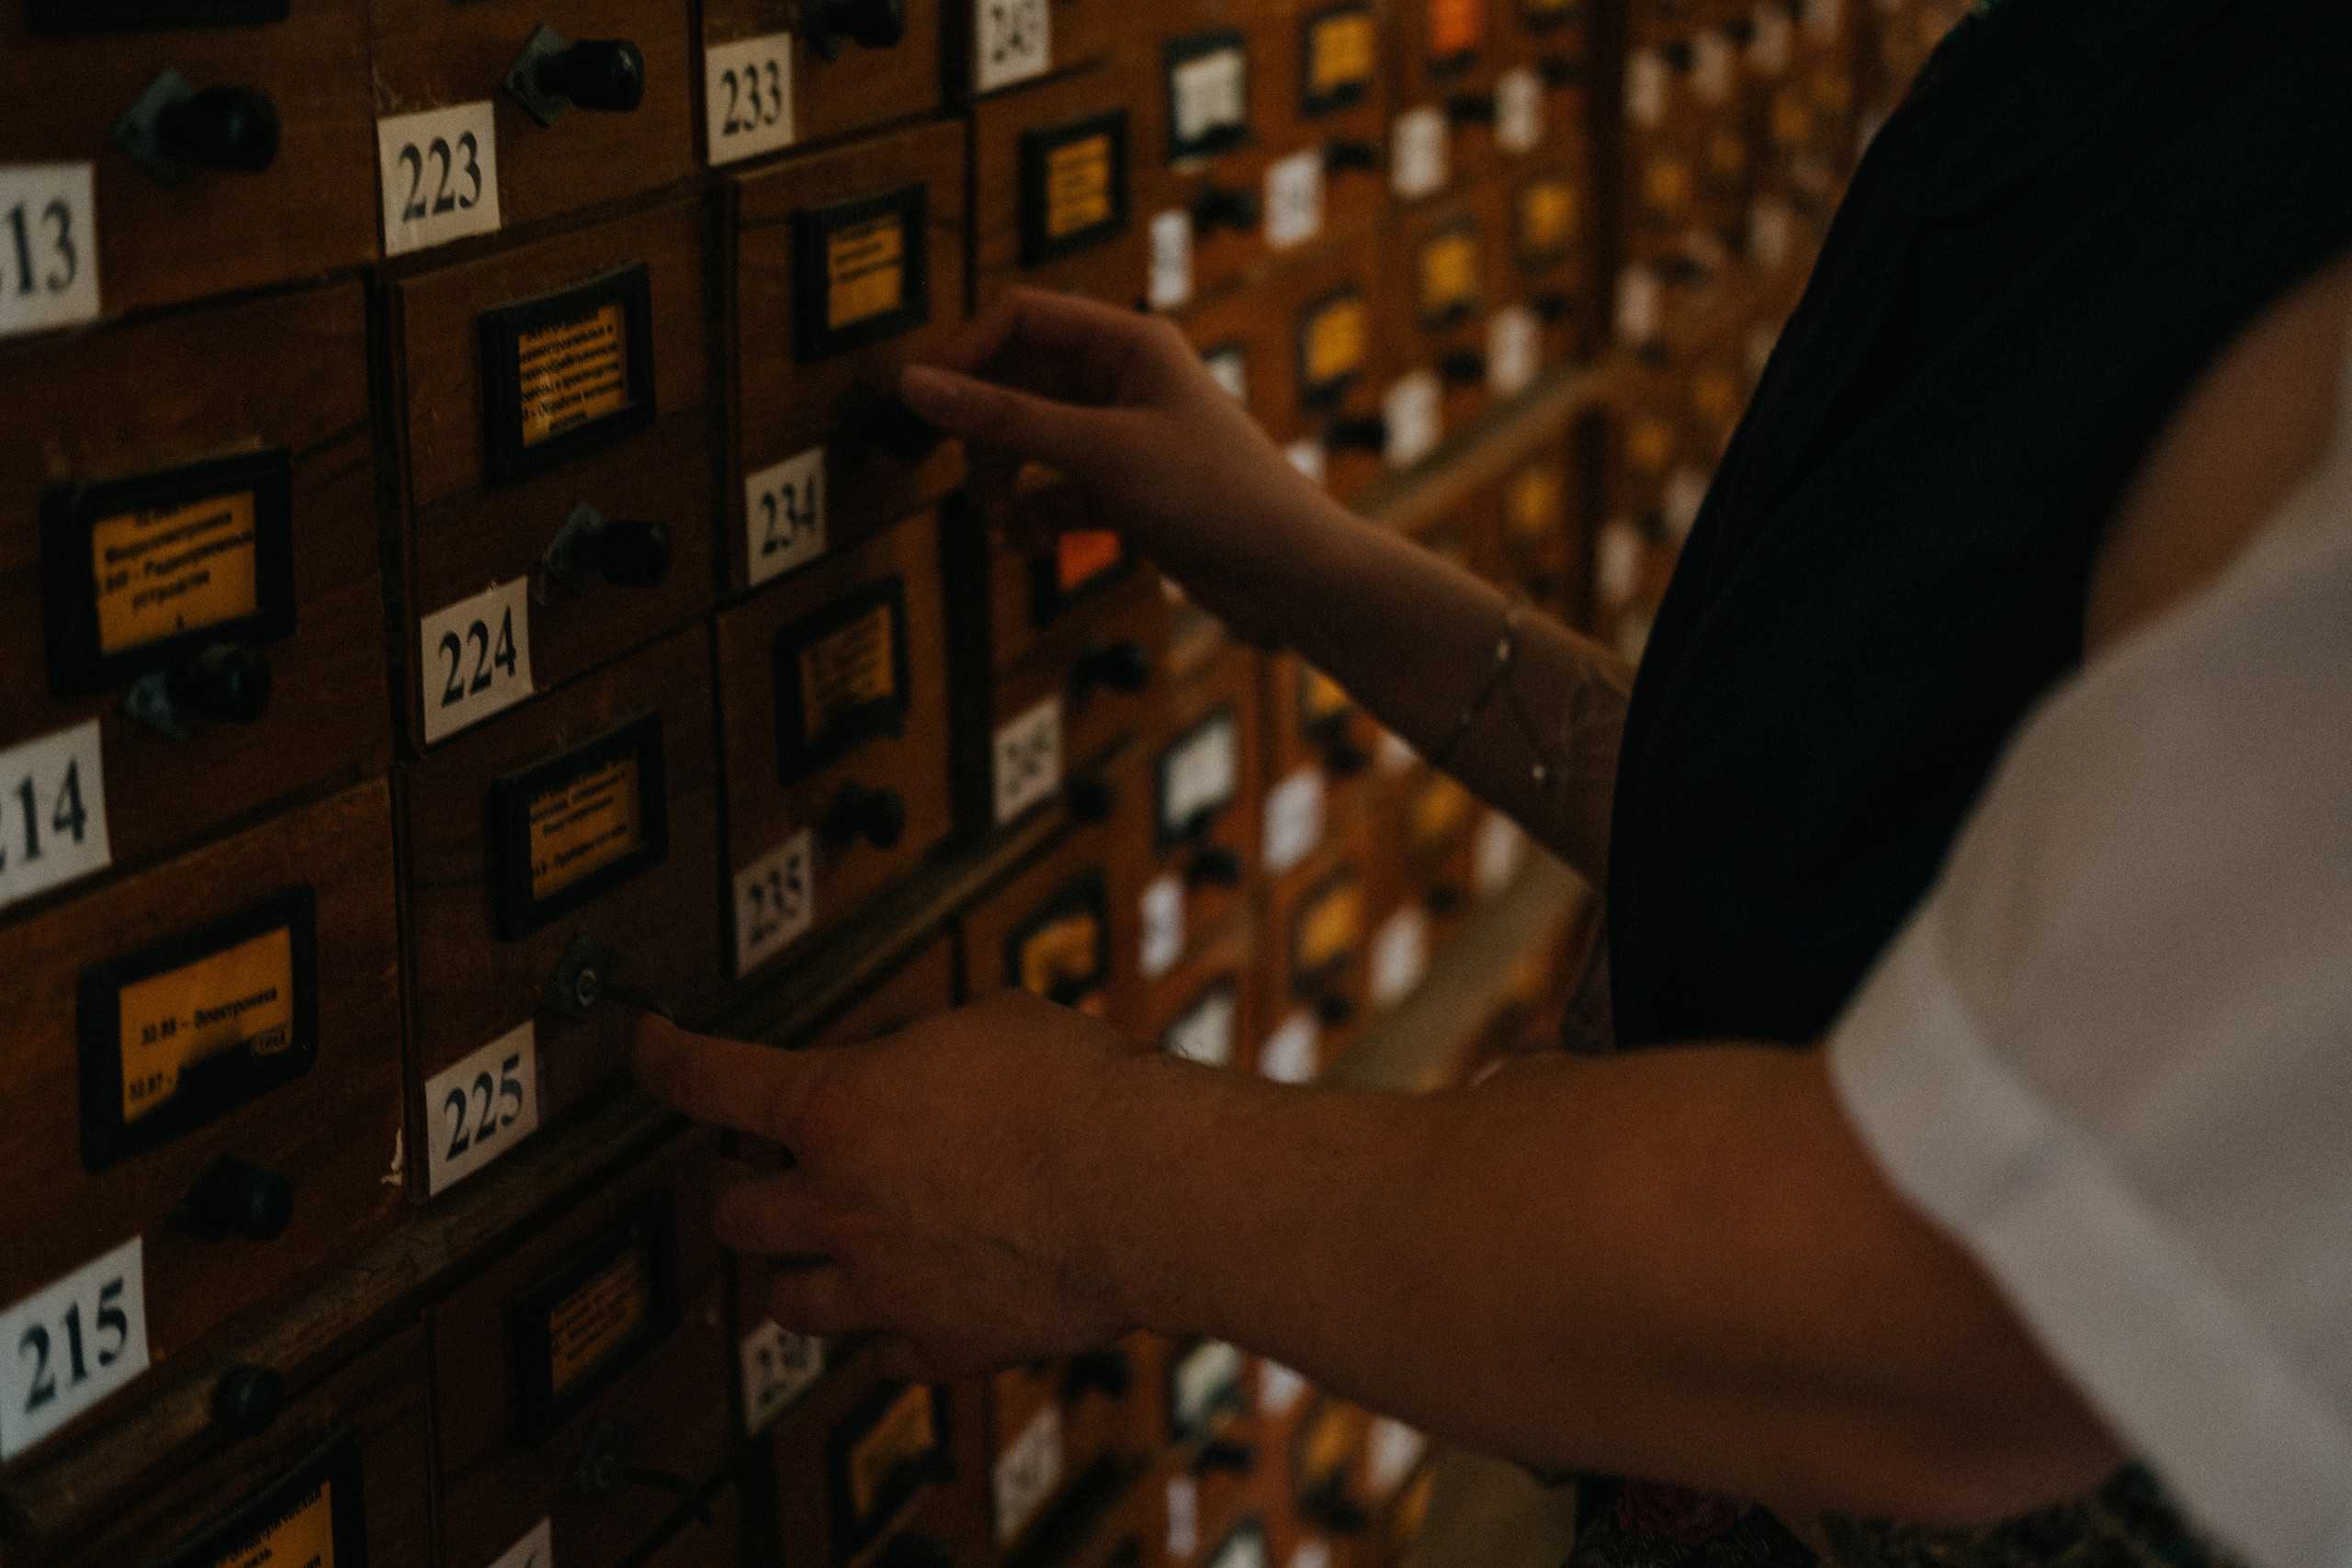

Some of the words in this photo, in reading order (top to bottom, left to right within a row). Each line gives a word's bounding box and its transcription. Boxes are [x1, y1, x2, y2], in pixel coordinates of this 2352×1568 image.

[720, 59, 782, 137] 233
[398, 130, 482, 224] 223
[0, 199, 79, 296] 13
[762, 475, 817, 558] 234
[437, 604, 517, 709] 224
[0, 759, 87, 872] 14
[748, 853, 803, 950] 235
[443, 1051, 524, 1164] 225
[18, 1275, 128, 1416] 215
